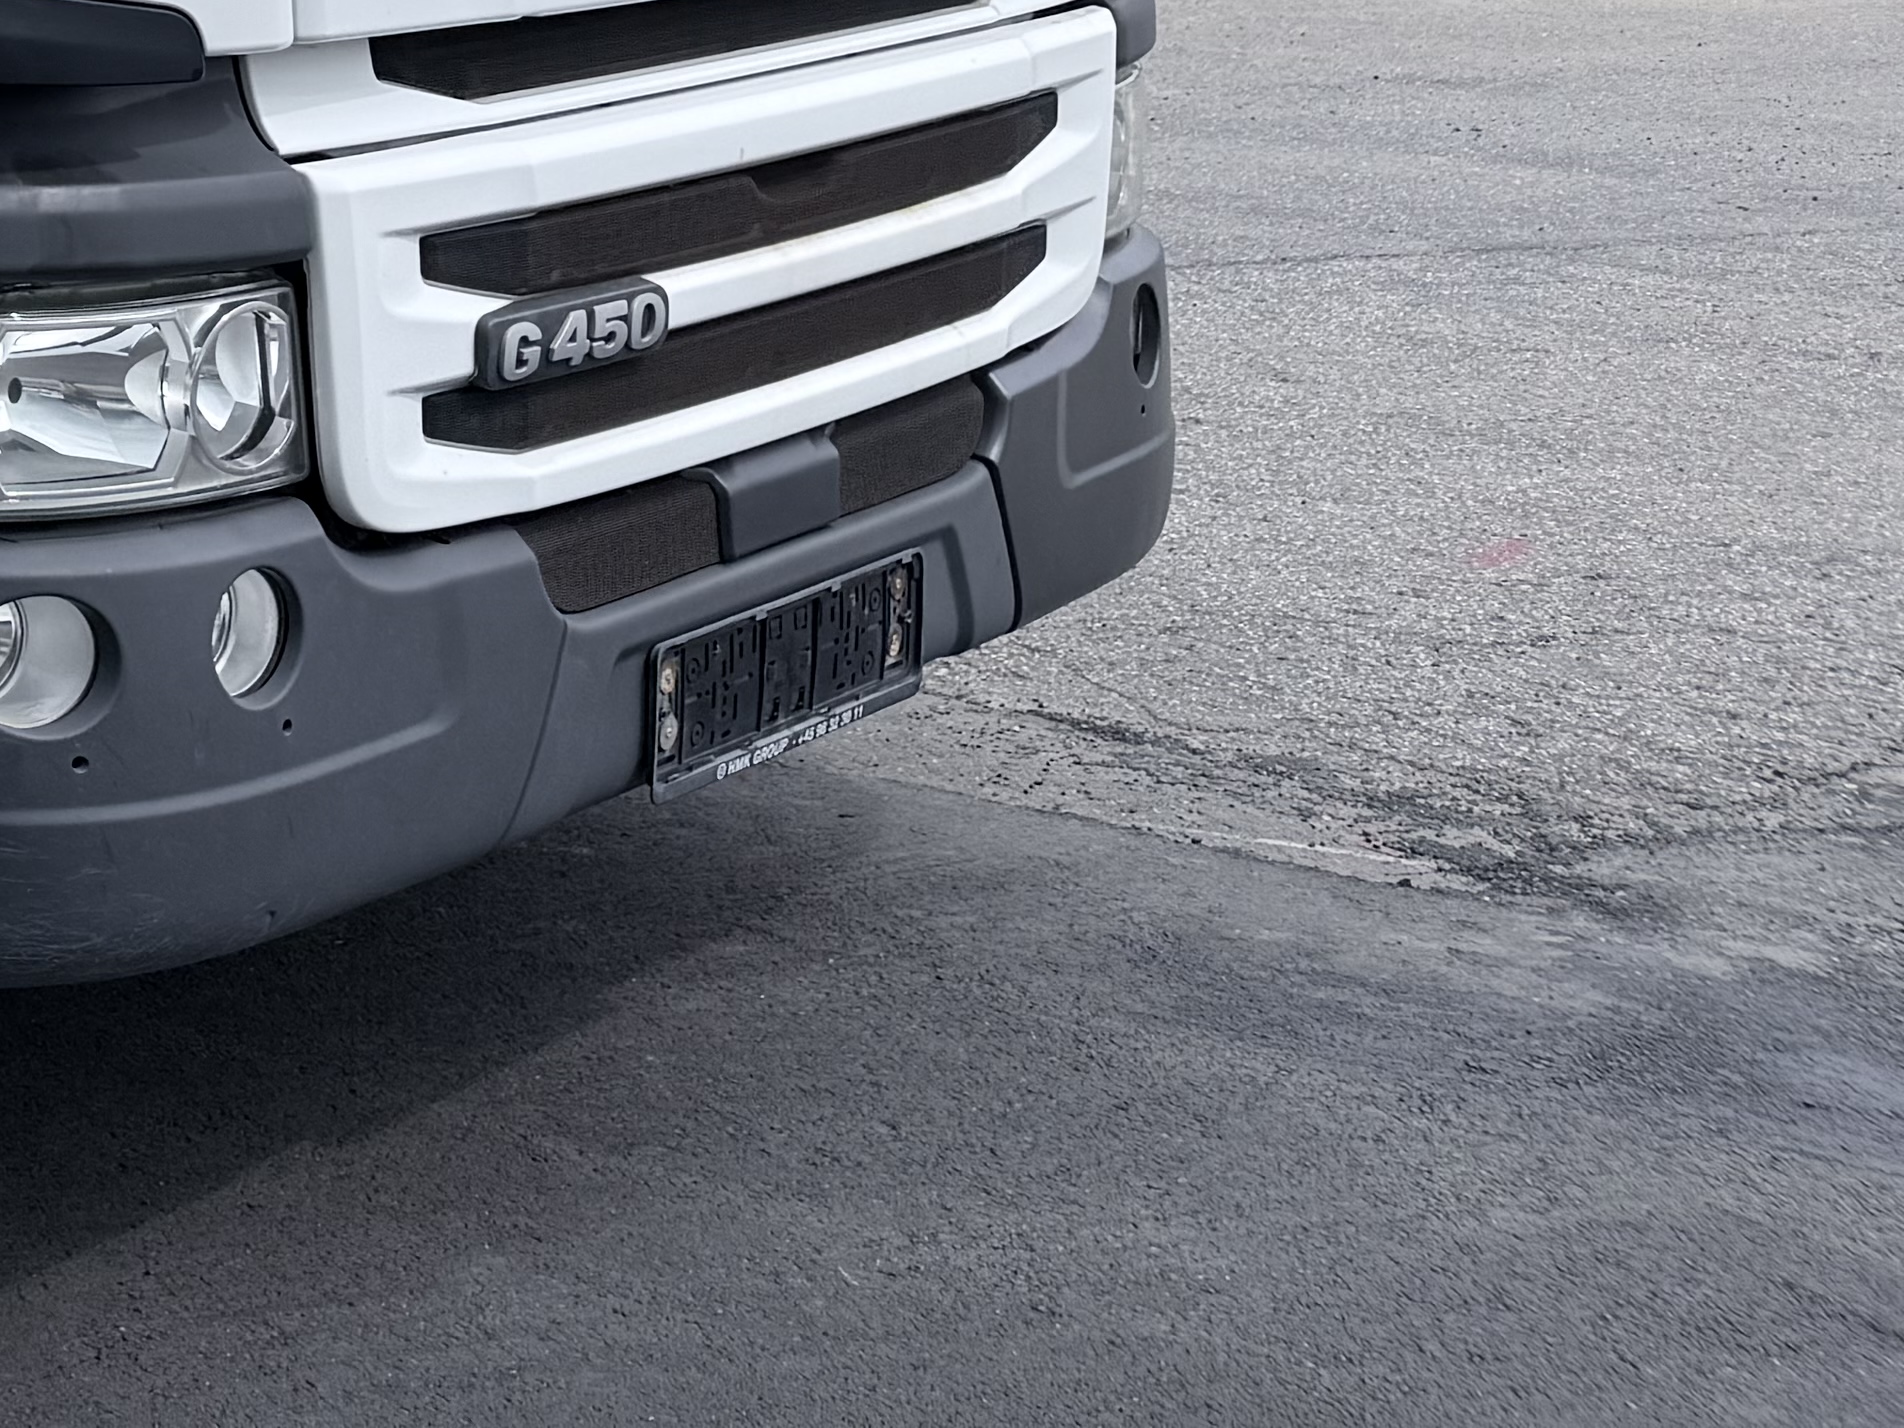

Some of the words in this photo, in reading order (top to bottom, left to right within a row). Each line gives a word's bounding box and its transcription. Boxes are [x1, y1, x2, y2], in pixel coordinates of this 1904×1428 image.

[498, 320, 543, 383] G
[548, 291, 667, 368] 450
[727, 754, 752, 775] HMK
[752, 737, 789, 764] GROUP
